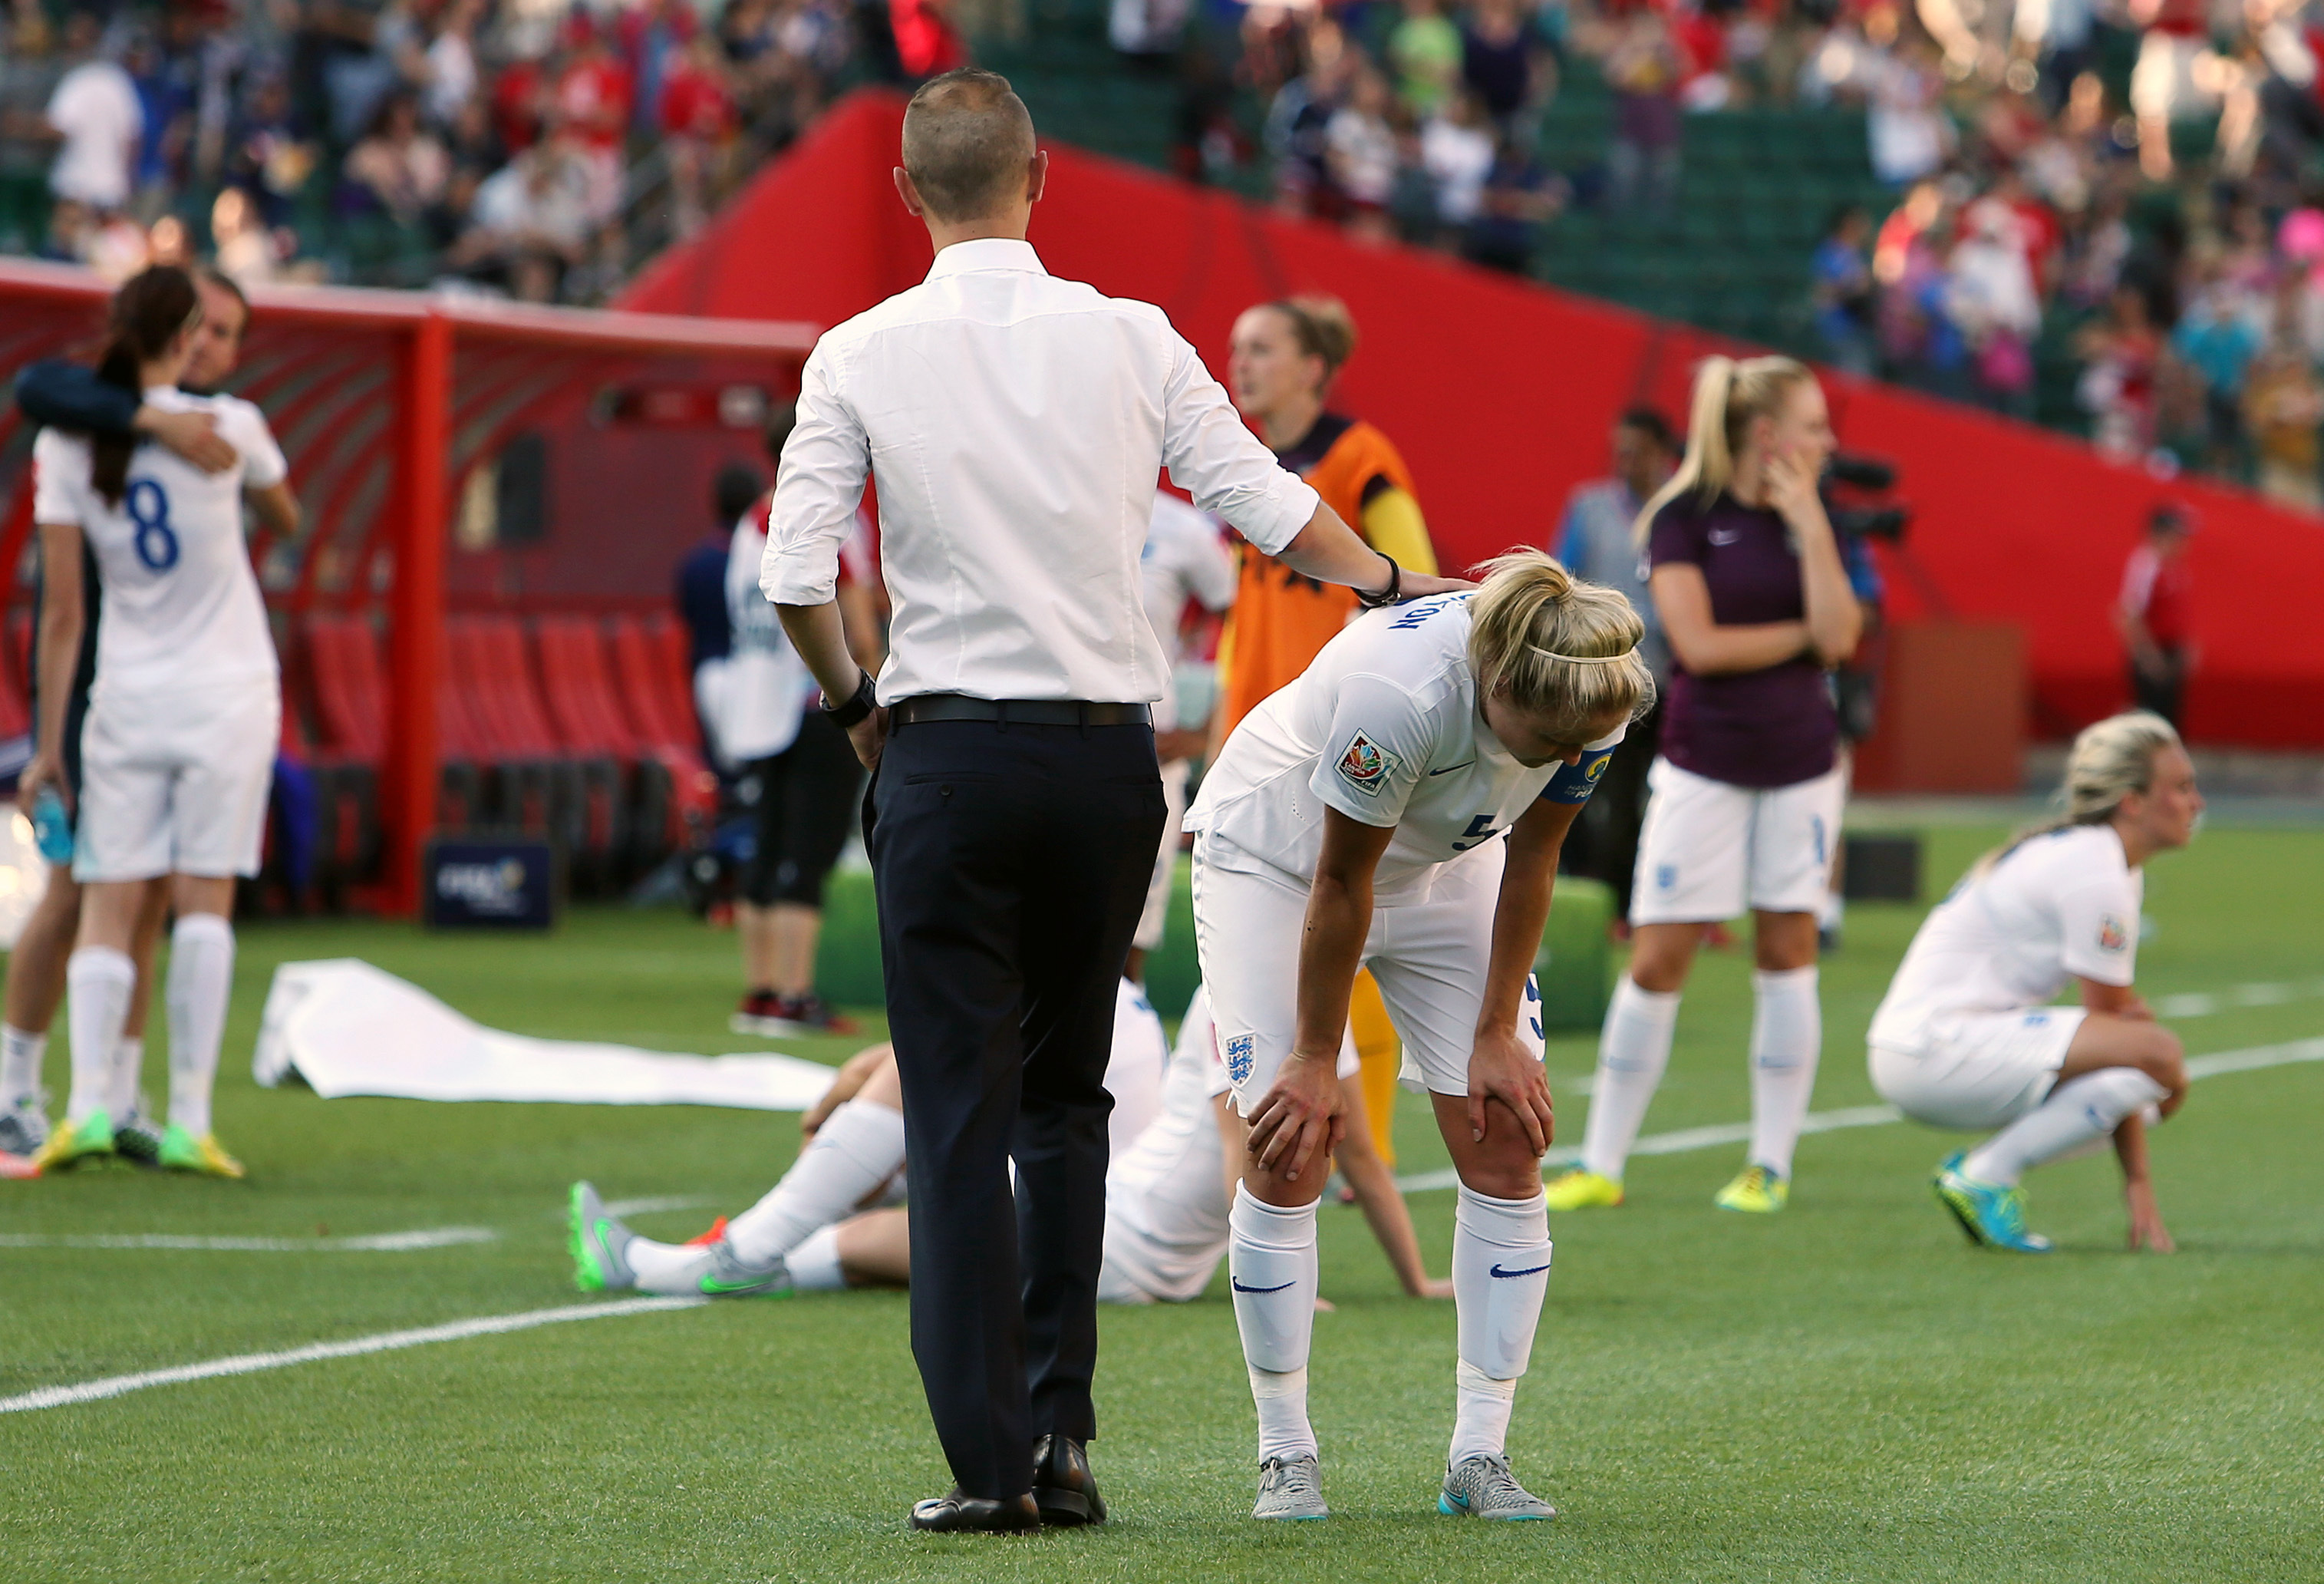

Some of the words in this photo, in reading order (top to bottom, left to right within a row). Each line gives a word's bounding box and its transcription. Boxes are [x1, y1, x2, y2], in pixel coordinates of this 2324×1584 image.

[127, 478, 179, 573] 8
[1361, 780, 1376, 789] FIFA
[1452, 814, 1498, 851] 5
